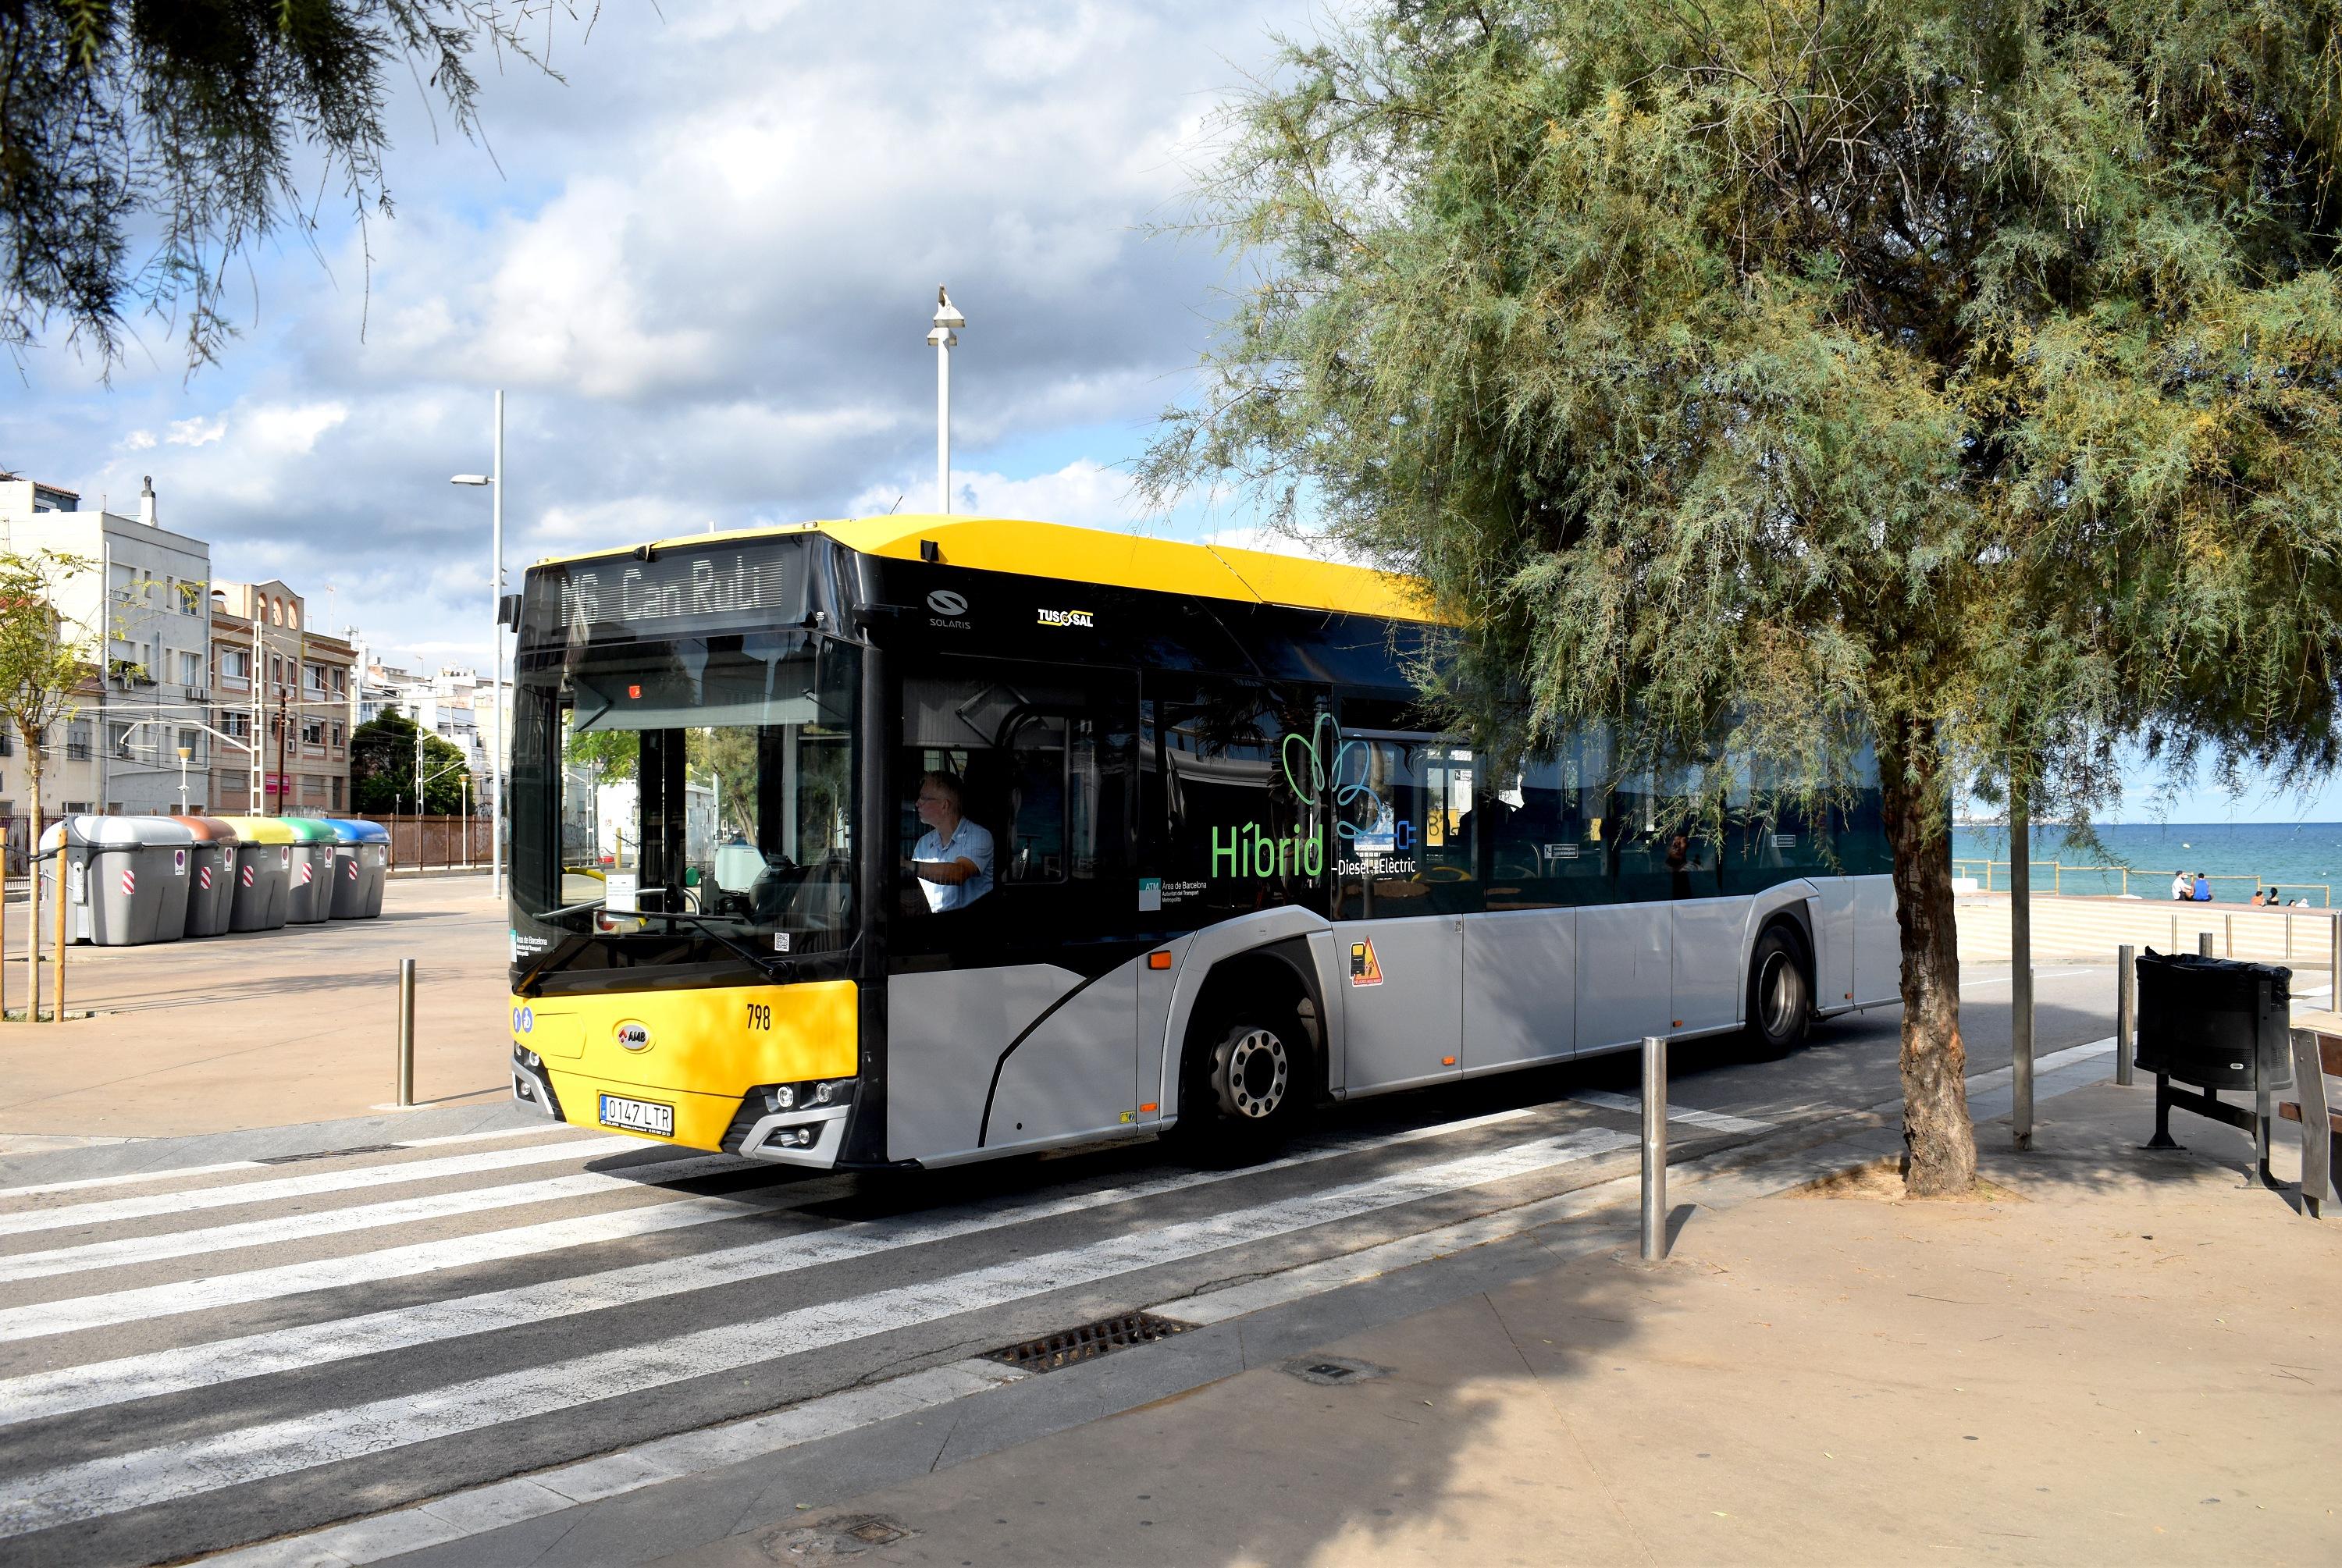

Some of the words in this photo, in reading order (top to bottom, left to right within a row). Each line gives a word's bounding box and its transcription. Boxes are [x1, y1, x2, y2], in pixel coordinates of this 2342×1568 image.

[623, 568, 681, 620] Can
[929, 618, 971, 629] SOLARIS
[1212, 820, 1323, 879] Híbrid
[1145, 882, 1159, 891] ATM
[1162, 880, 1174, 890] Àrea
[1175, 881, 1182, 890] de
[1182, 880, 1207, 890] Barcelona
[529, 936, 547, 945] Barcelona
[746, 1003, 771, 1031] 798
[628, 1031, 646, 1042] AMB
[609, 1100, 640, 1122] 0147
[644, 1105, 669, 1129] LTR
